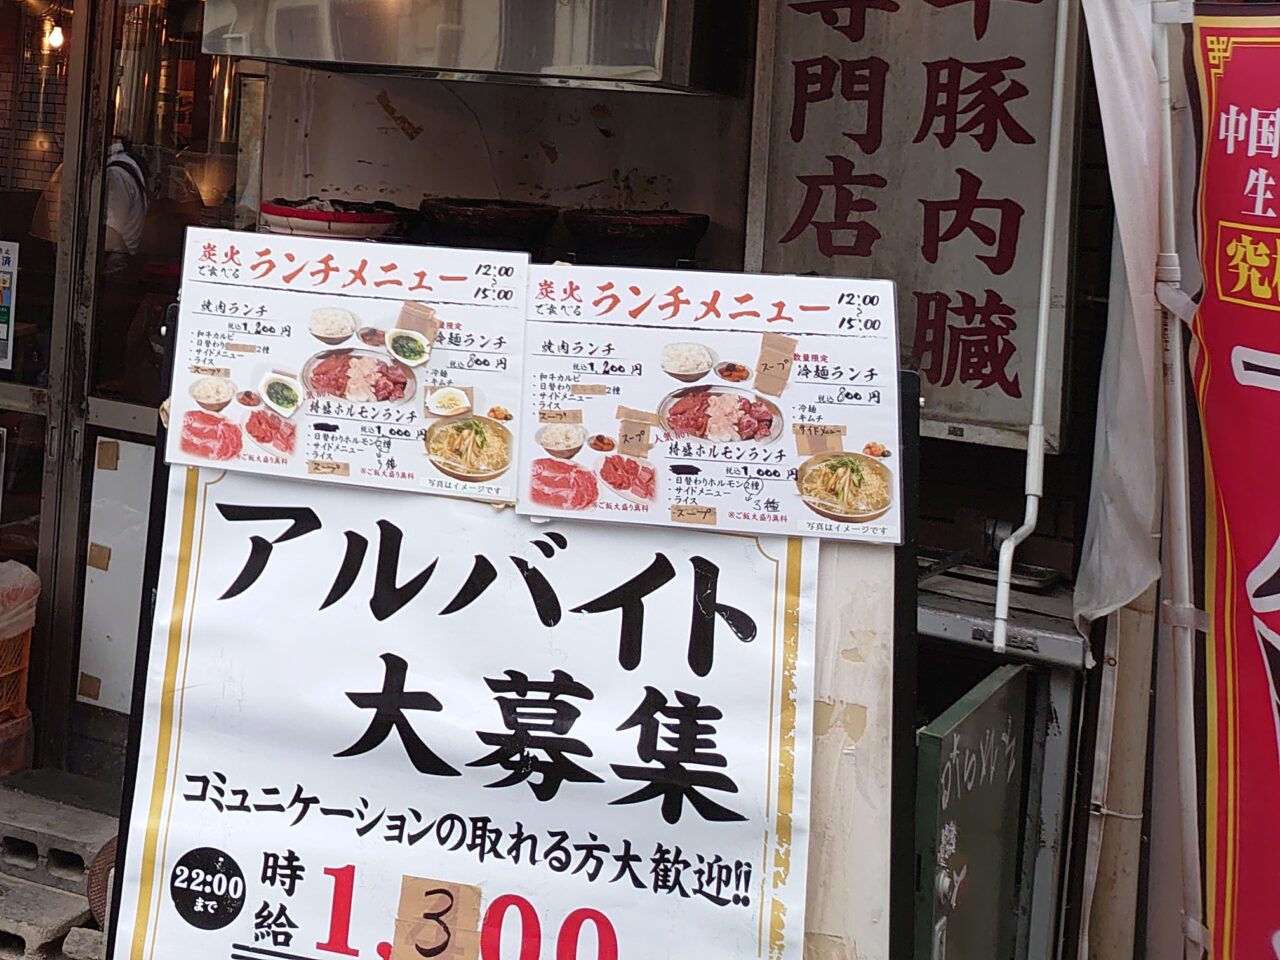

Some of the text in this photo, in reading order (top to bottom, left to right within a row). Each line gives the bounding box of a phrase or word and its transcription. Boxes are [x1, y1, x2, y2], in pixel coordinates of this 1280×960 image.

[198, 242, 242, 267] 炭火
[249, 247, 468, 292] ランチメニュー
[474, 263, 514, 278] 12:00
[473, 287, 514, 301] 15:00
[535, 279, 583, 303] 炭火
[837, 292, 880, 307] 12:00
[200, 299, 268, 317] 焼肉ランチ
[592, 281, 831, 324] ランチメニュー
[838, 317, 881, 331] 15:00
[541, 339, 615, 356] 焼肉ランチ
[760, 358, 790, 373] スープ
[793, 353, 829, 363] 数量限定
[797, 364, 878, 382] 冷麺ランチ
[309, 400, 418, 424] 特盛ホルモンランチ
[538, 401, 561, 410] ライス
[797, 413, 824, 423] キムチ
[621, 429, 646, 445] スープ
[668, 442, 787, 463] 特盛ホルモンランチ
[428, 478, 501, 495] 写真はイメージです
[673, 496, 699, 505] ライス
[806, 521, 889, 536] 写真はイメージです
[216, 501, 758, 677] アルバイト
[332, 652, 750, 824] 大募集
[173, 865, 244, 899] 22:00
[193, 897, 219, 915] まで
[253, 849, 306, 947] 時給
